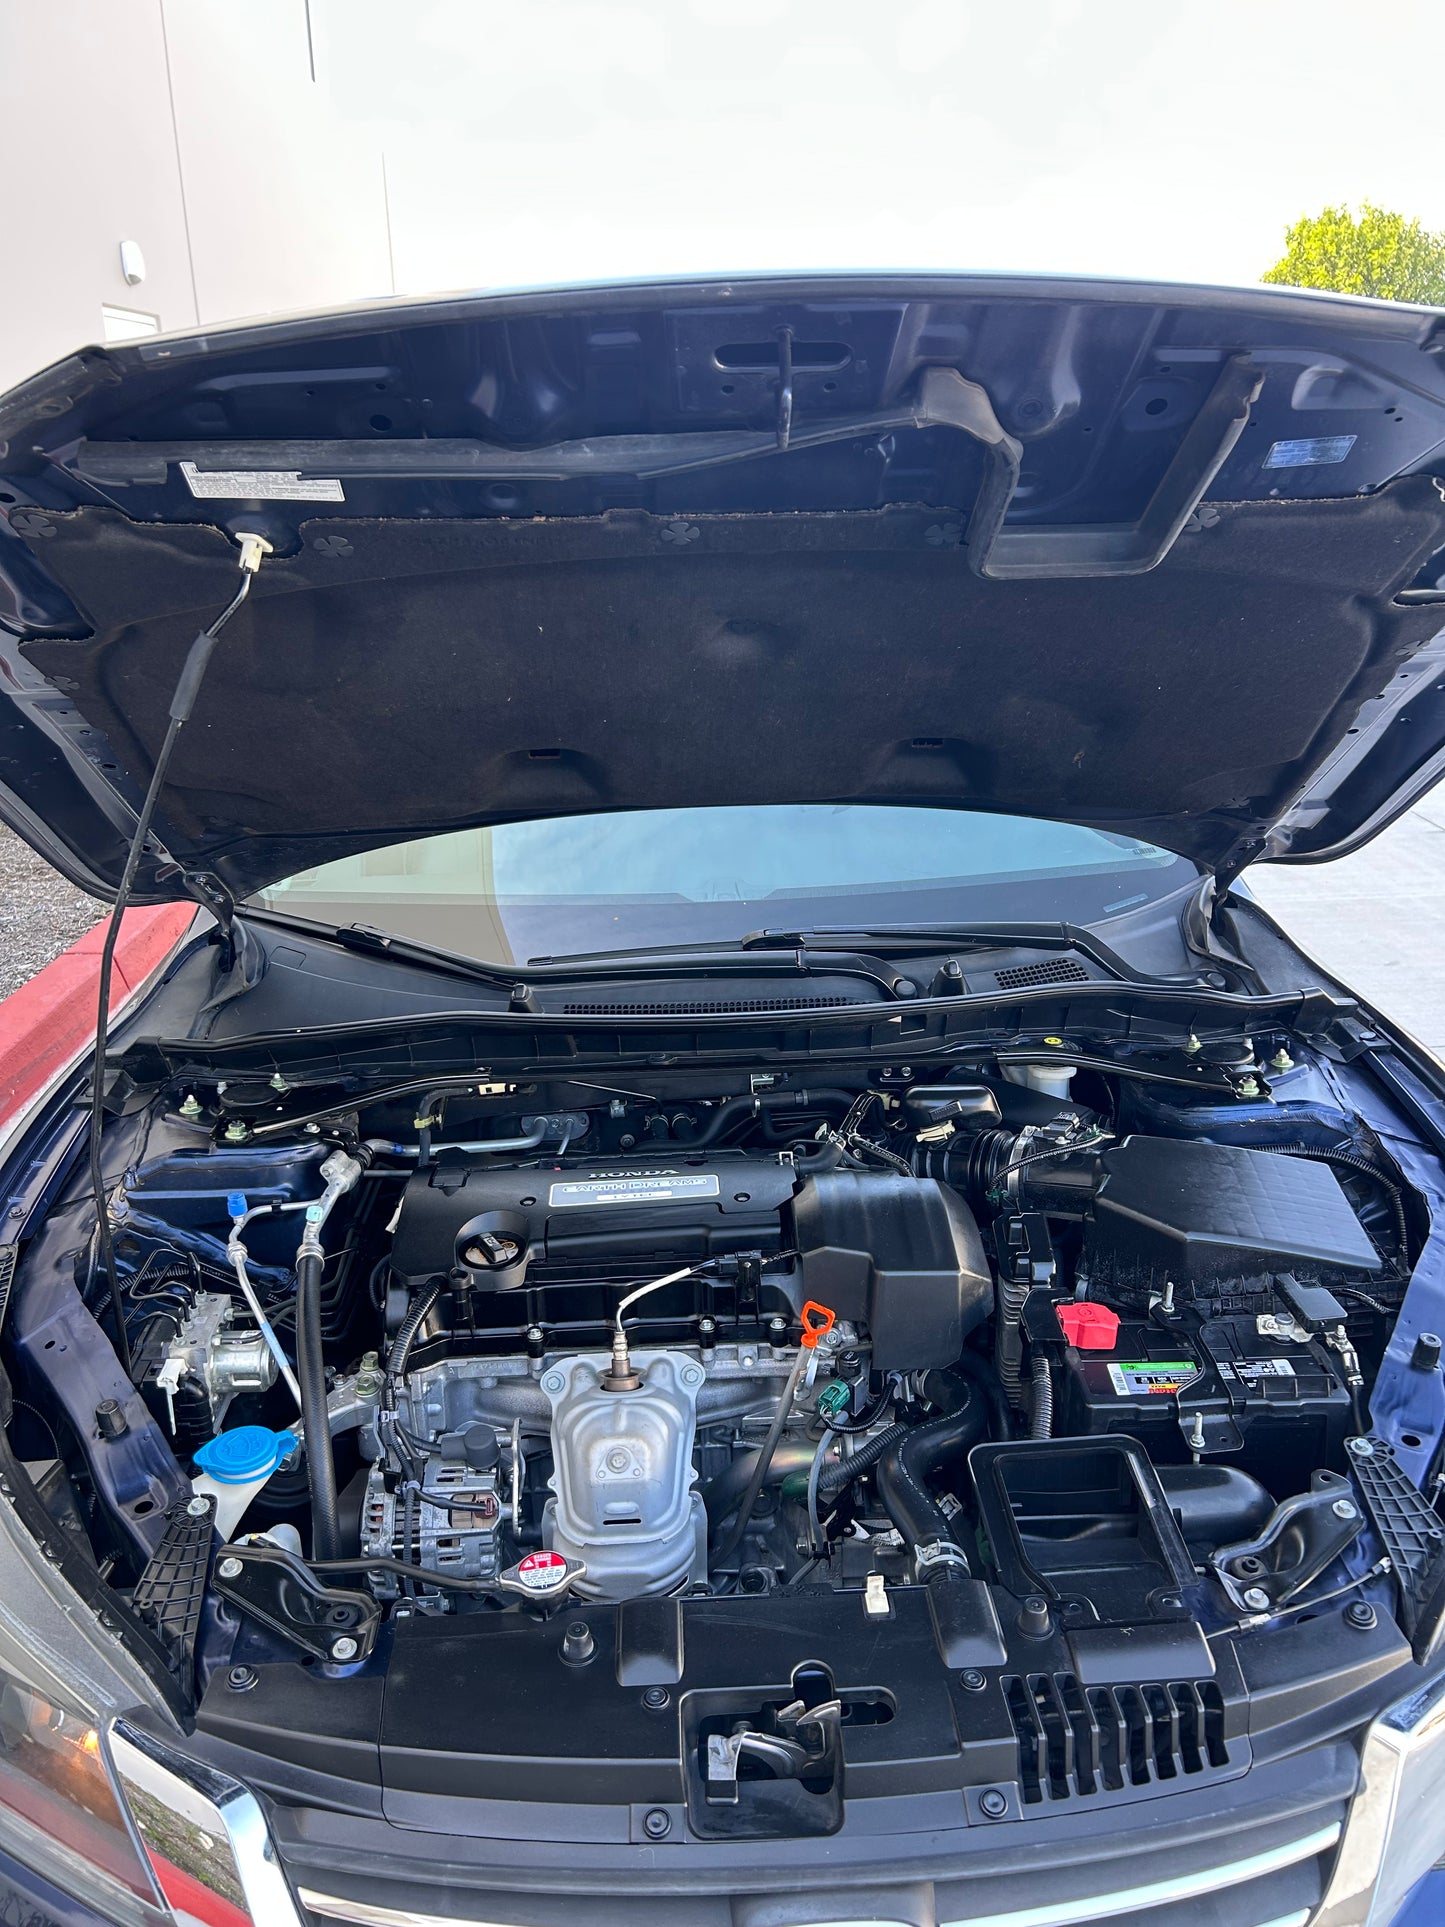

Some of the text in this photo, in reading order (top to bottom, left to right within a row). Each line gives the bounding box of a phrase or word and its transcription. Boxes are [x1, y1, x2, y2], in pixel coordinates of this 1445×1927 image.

[588, 1169, 680, 1179] HONDA
[562, 1179, 708, 1193] EARTH DREAMS
